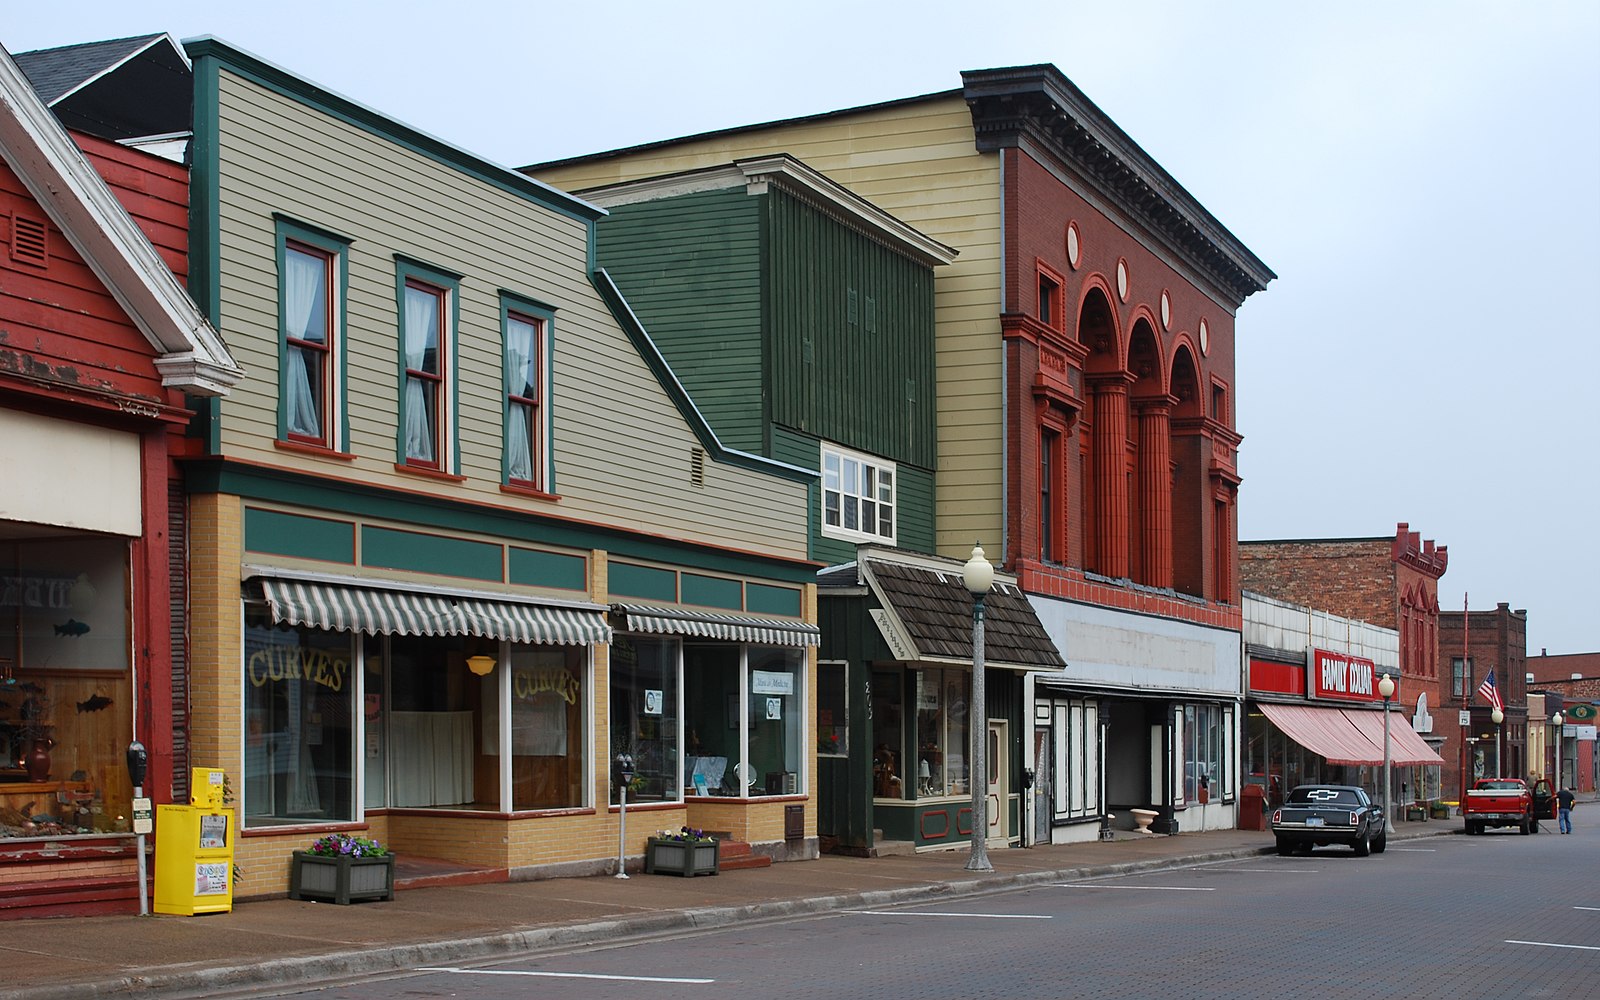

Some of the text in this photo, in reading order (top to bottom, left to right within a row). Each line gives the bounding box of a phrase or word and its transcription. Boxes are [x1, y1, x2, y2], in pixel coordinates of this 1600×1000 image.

[249, 645, 347, 692] CURVES
[514, 666, 580, 705] CURVES
[1321, 657, 1373, 695] FAMILY DOLLAR
